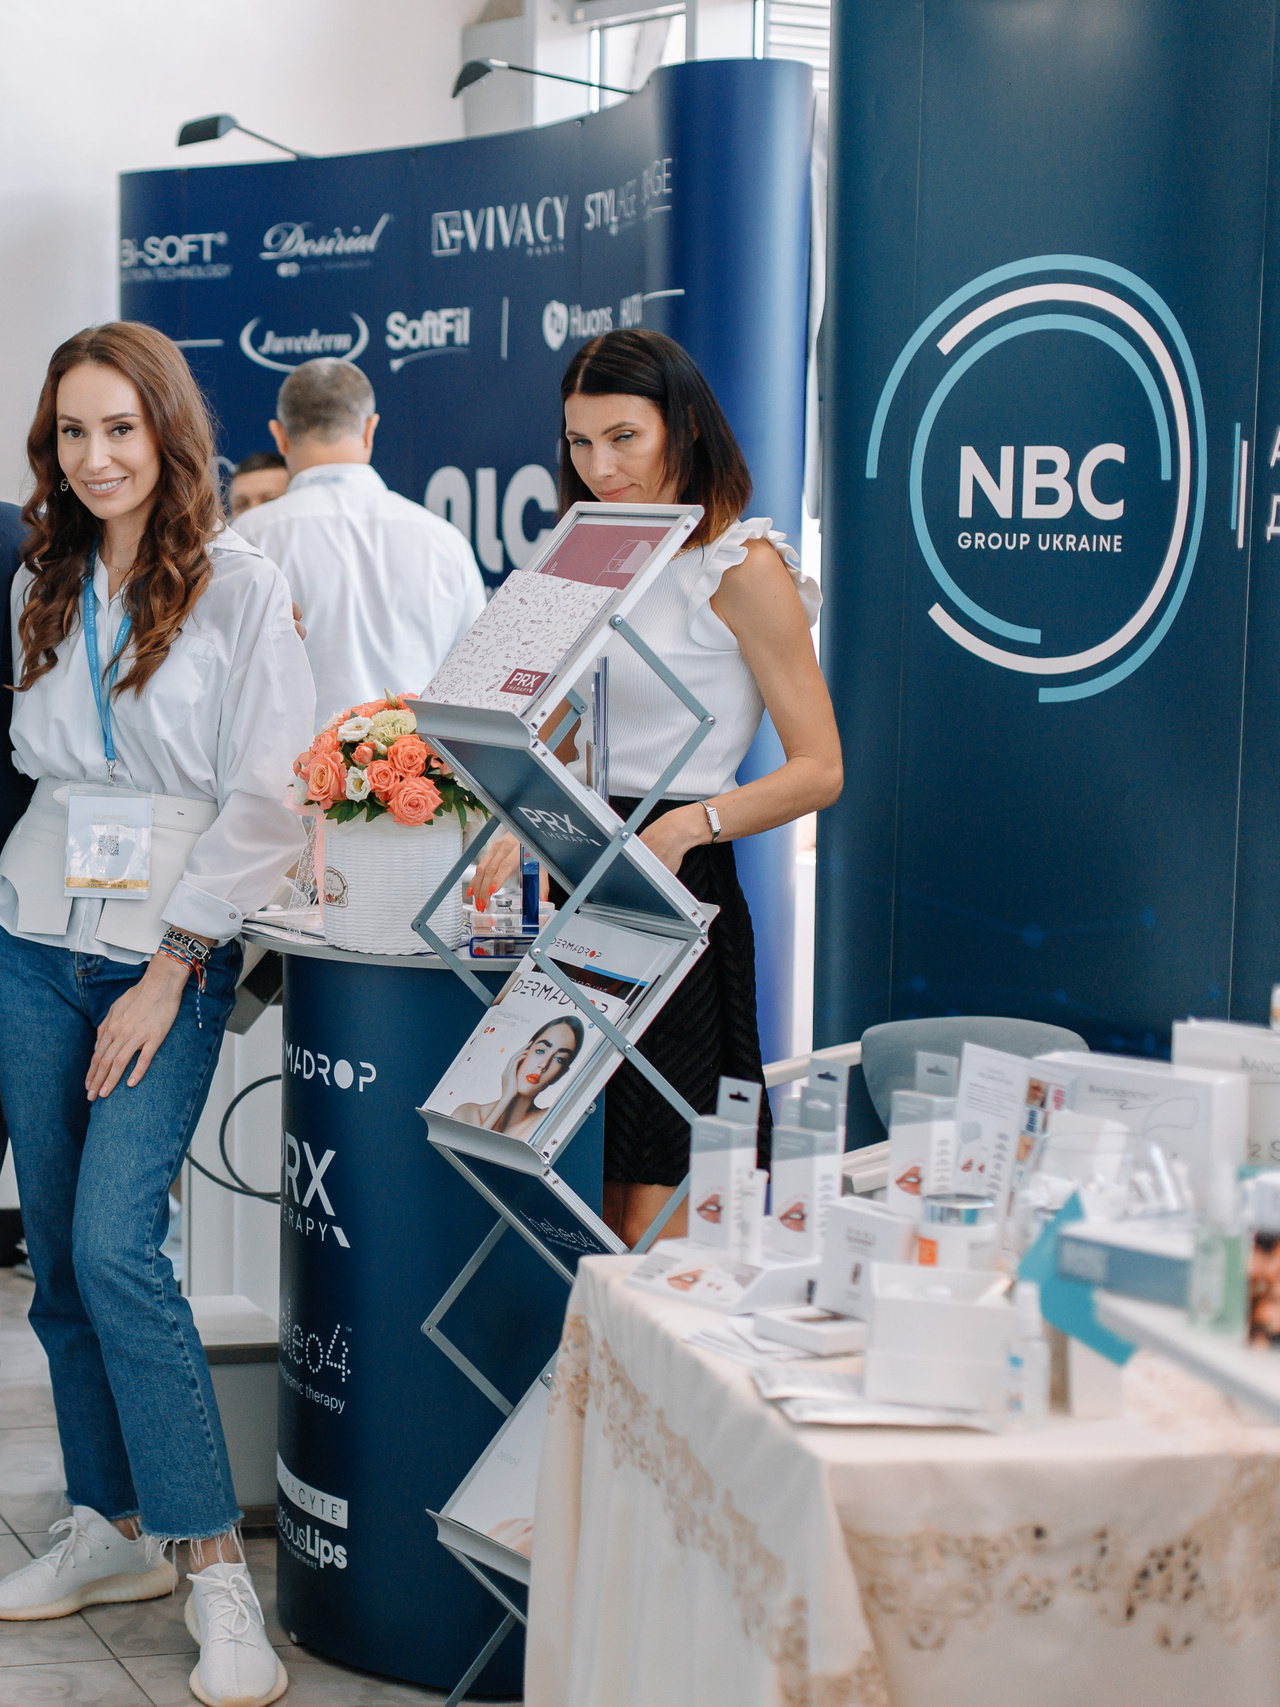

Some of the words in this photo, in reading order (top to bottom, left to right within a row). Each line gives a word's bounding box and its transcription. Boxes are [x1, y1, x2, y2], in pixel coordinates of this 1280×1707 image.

[462, 196, 568, 252] VIVACY
[386, 307, 470, 350] SoftFil
[569, 304, 613, 338] Huons
[958, 443, 1125, 520] NBC
[957, 531, 1030, 550] GROUP
[1038, 533, 1122, 552] UKRAINE
[509, 672, 541, 688] PRX
[517, 806, 587, 837] PRX
[540, 830, 591, 845] THERAPY
[306, 1384, 345, 1414] therapy
